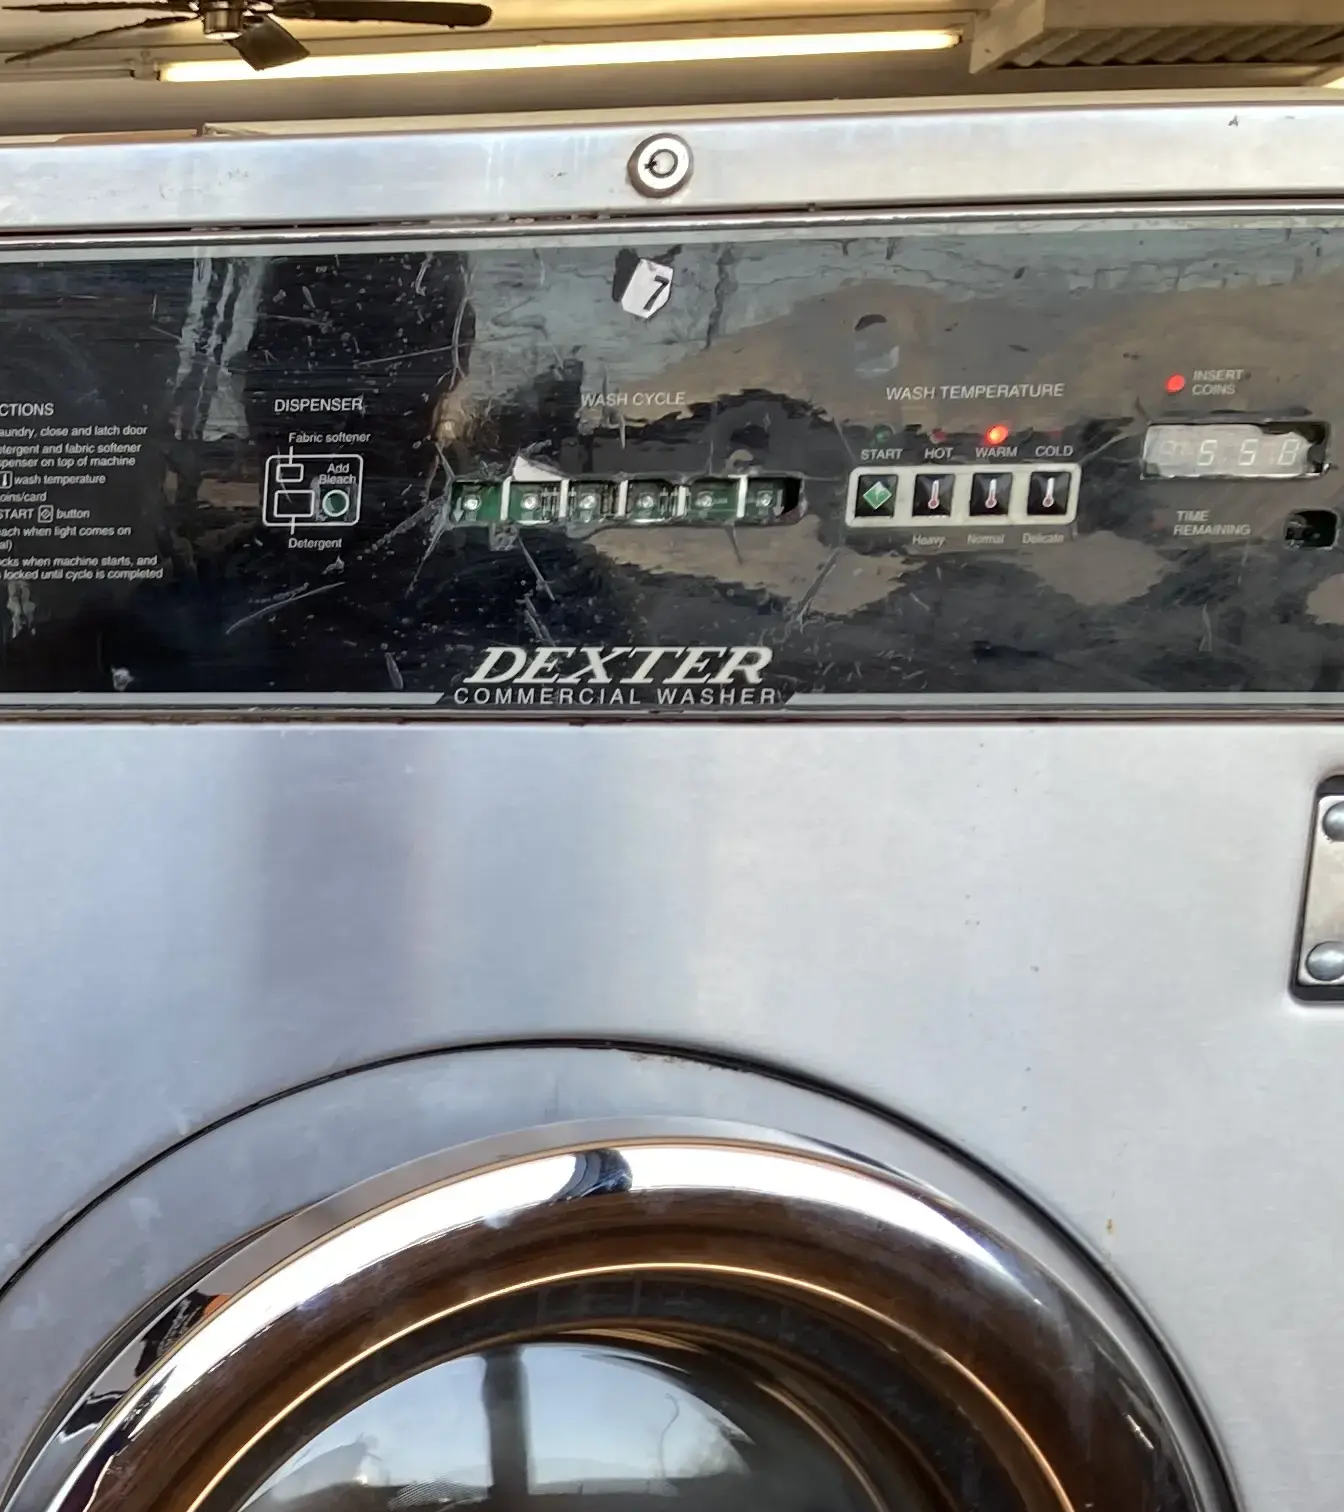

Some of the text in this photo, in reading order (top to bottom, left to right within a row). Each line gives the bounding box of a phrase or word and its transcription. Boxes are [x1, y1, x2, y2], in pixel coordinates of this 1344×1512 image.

[643, 276, 669, 311] 7
[1193, 370, 1244, 380] INSERT
[886, 383, 1065, 400] WASH TEMPERATURE
[1192, 384, 1235, 395] COINS
[274, 398, 363, 412] DISPENSER
[581, 392, 685, 407] WASH CYCLE
[40, 427, 68, 436] close
[72, 427, 92, 436] and
[95, 426, 120, 436] latch
[123, 426, 147, 435] door
[289, 432, 371, 443] Fabric softener
[42, 444, 62, 454] and
[65, 444, 95, 453] fabric
[97, 443, 141, 453] softener
[861, 445, 1073, 460] START HOT WARM COLD
[327, 463, 349, 473] Add
[319, 475, 356, 484] Bleach
[1177, 510, 1209, 521] TIME
[1173, 524, 1251, 536] REMAINING
[288, 538, 342, 549] Detergent
[913, 533, 1064, 547] Heavy Normal Delicate
[463, 646, 774, 685] DEXTER
[454, 687, 776, 705] COMMERCIAL WASHER
